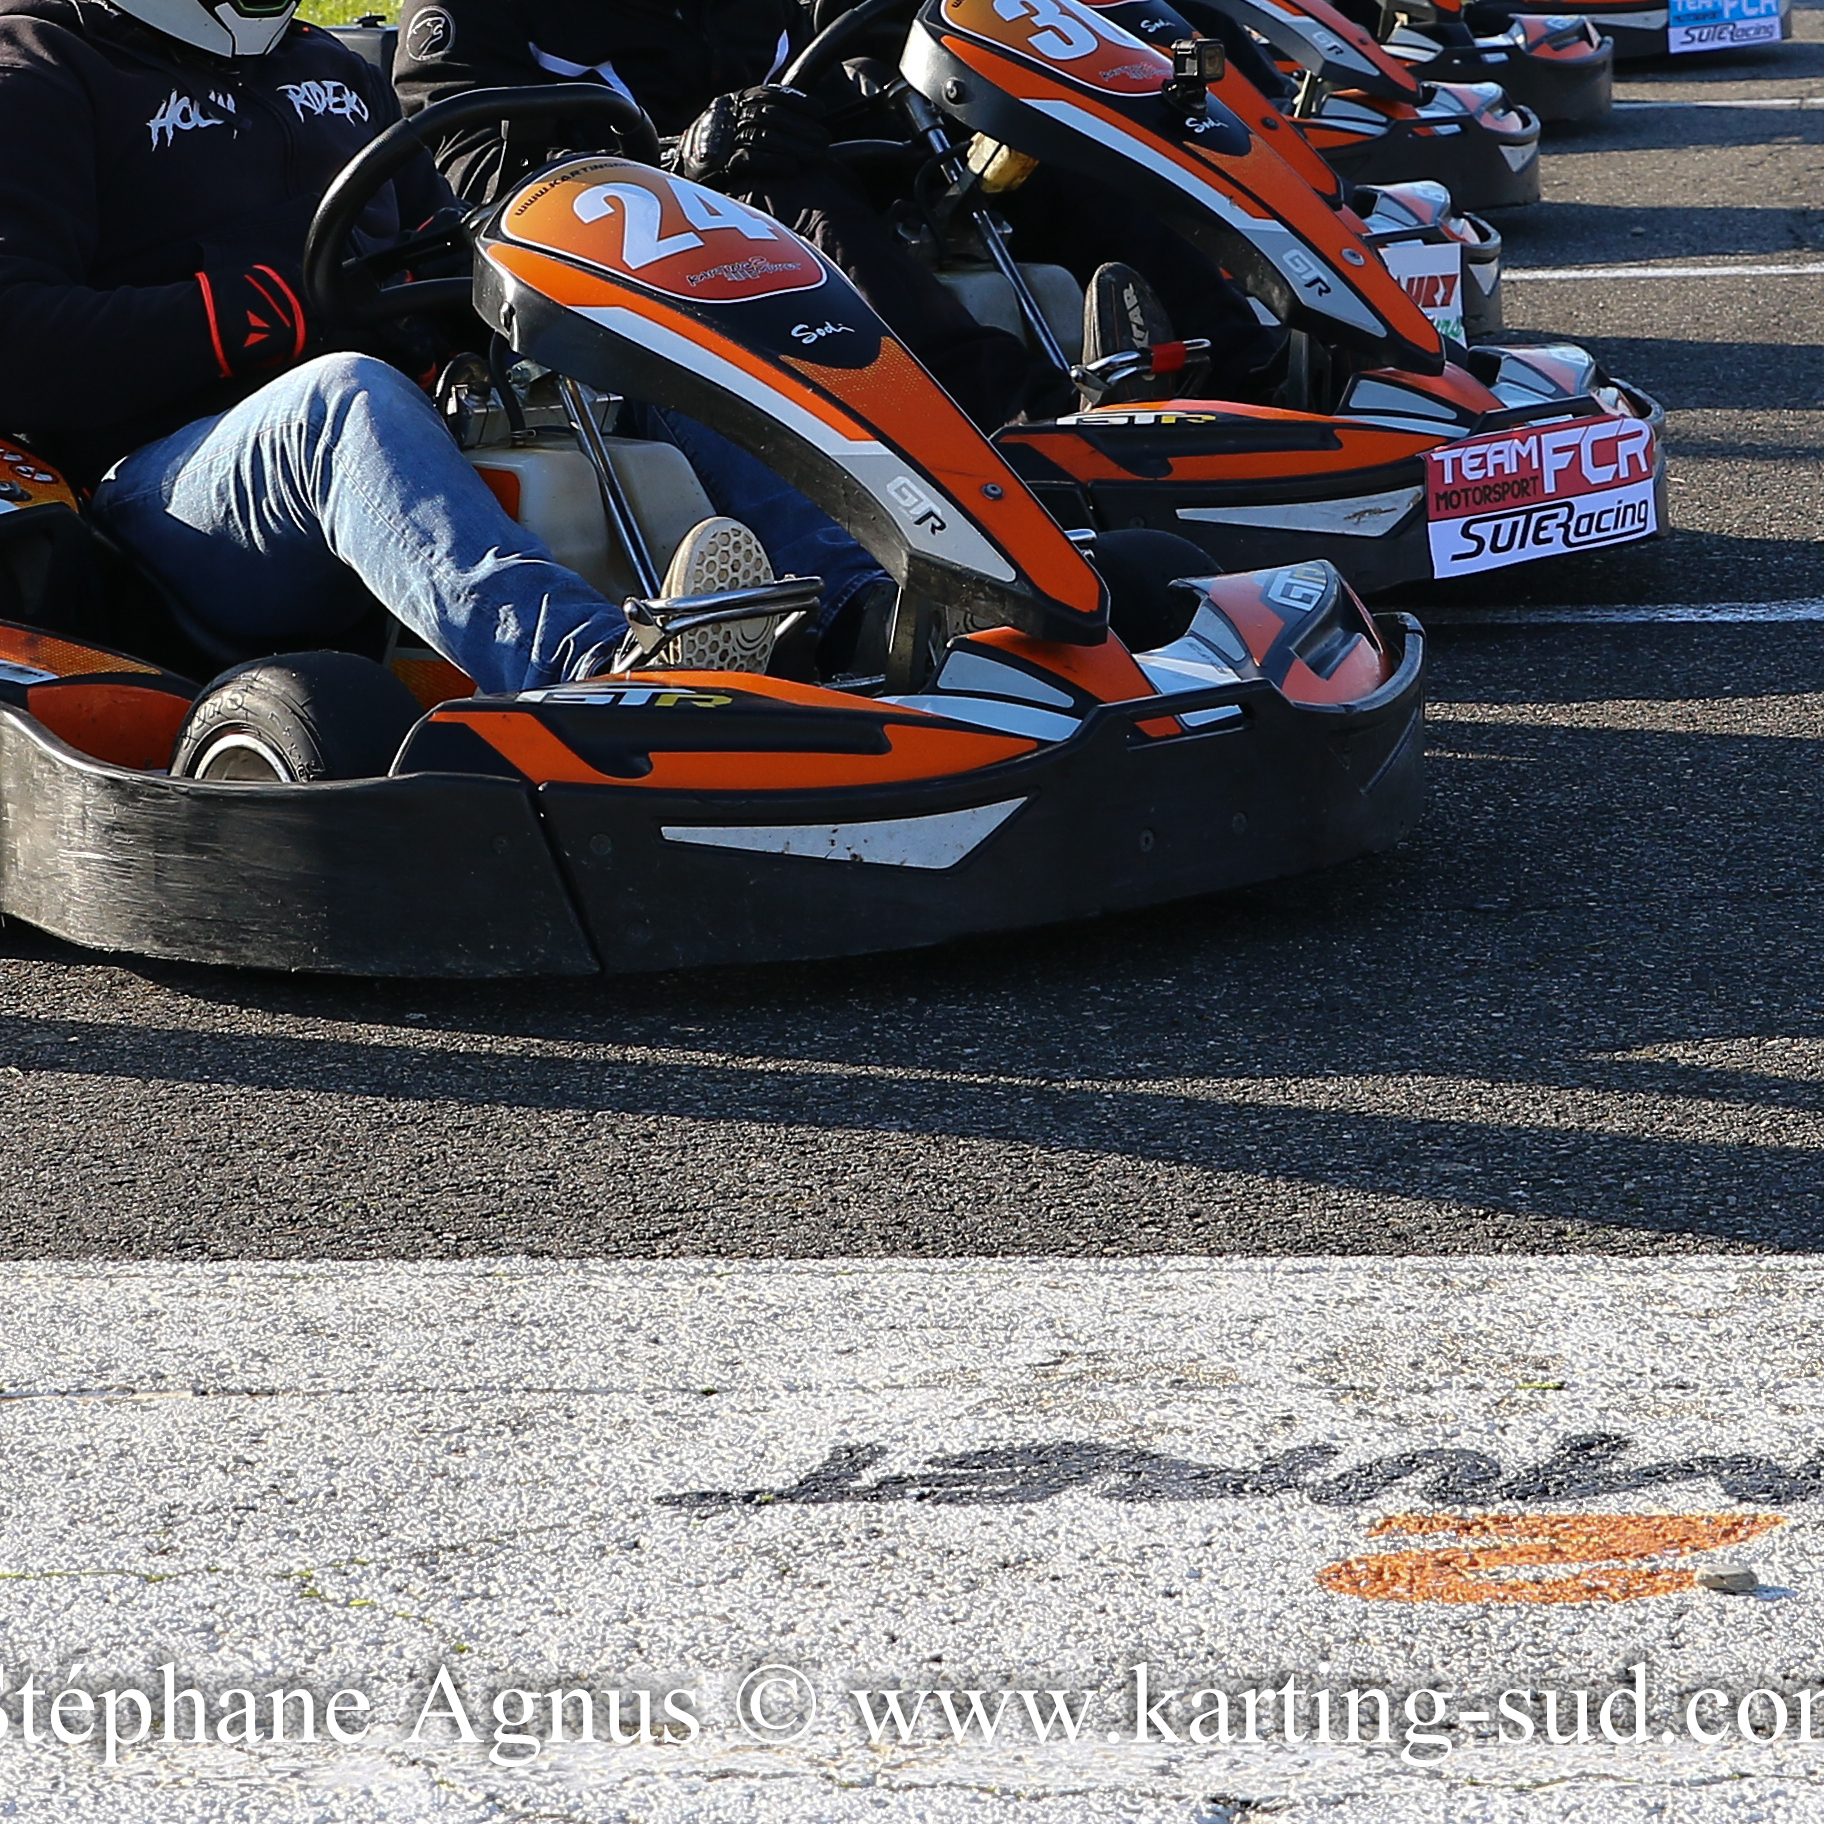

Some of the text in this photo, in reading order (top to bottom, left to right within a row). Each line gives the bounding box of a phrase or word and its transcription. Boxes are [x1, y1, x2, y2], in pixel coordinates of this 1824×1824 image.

[571, 178, 779, 271] 24
[686, 260, 754, 287] KARTING
[1282, 248, 1331, 297] GTR
[1396, 273, 1461, 308] URY
[790, 320, 856, 345] Sodi
[1430, 417, 1651, 494] TEAM FCR
[886, 476, 947, 536] GTR
[1435, 475, 1539, 512] MOTORSPORT
[1315, 1511, 1786, 1606] 2
